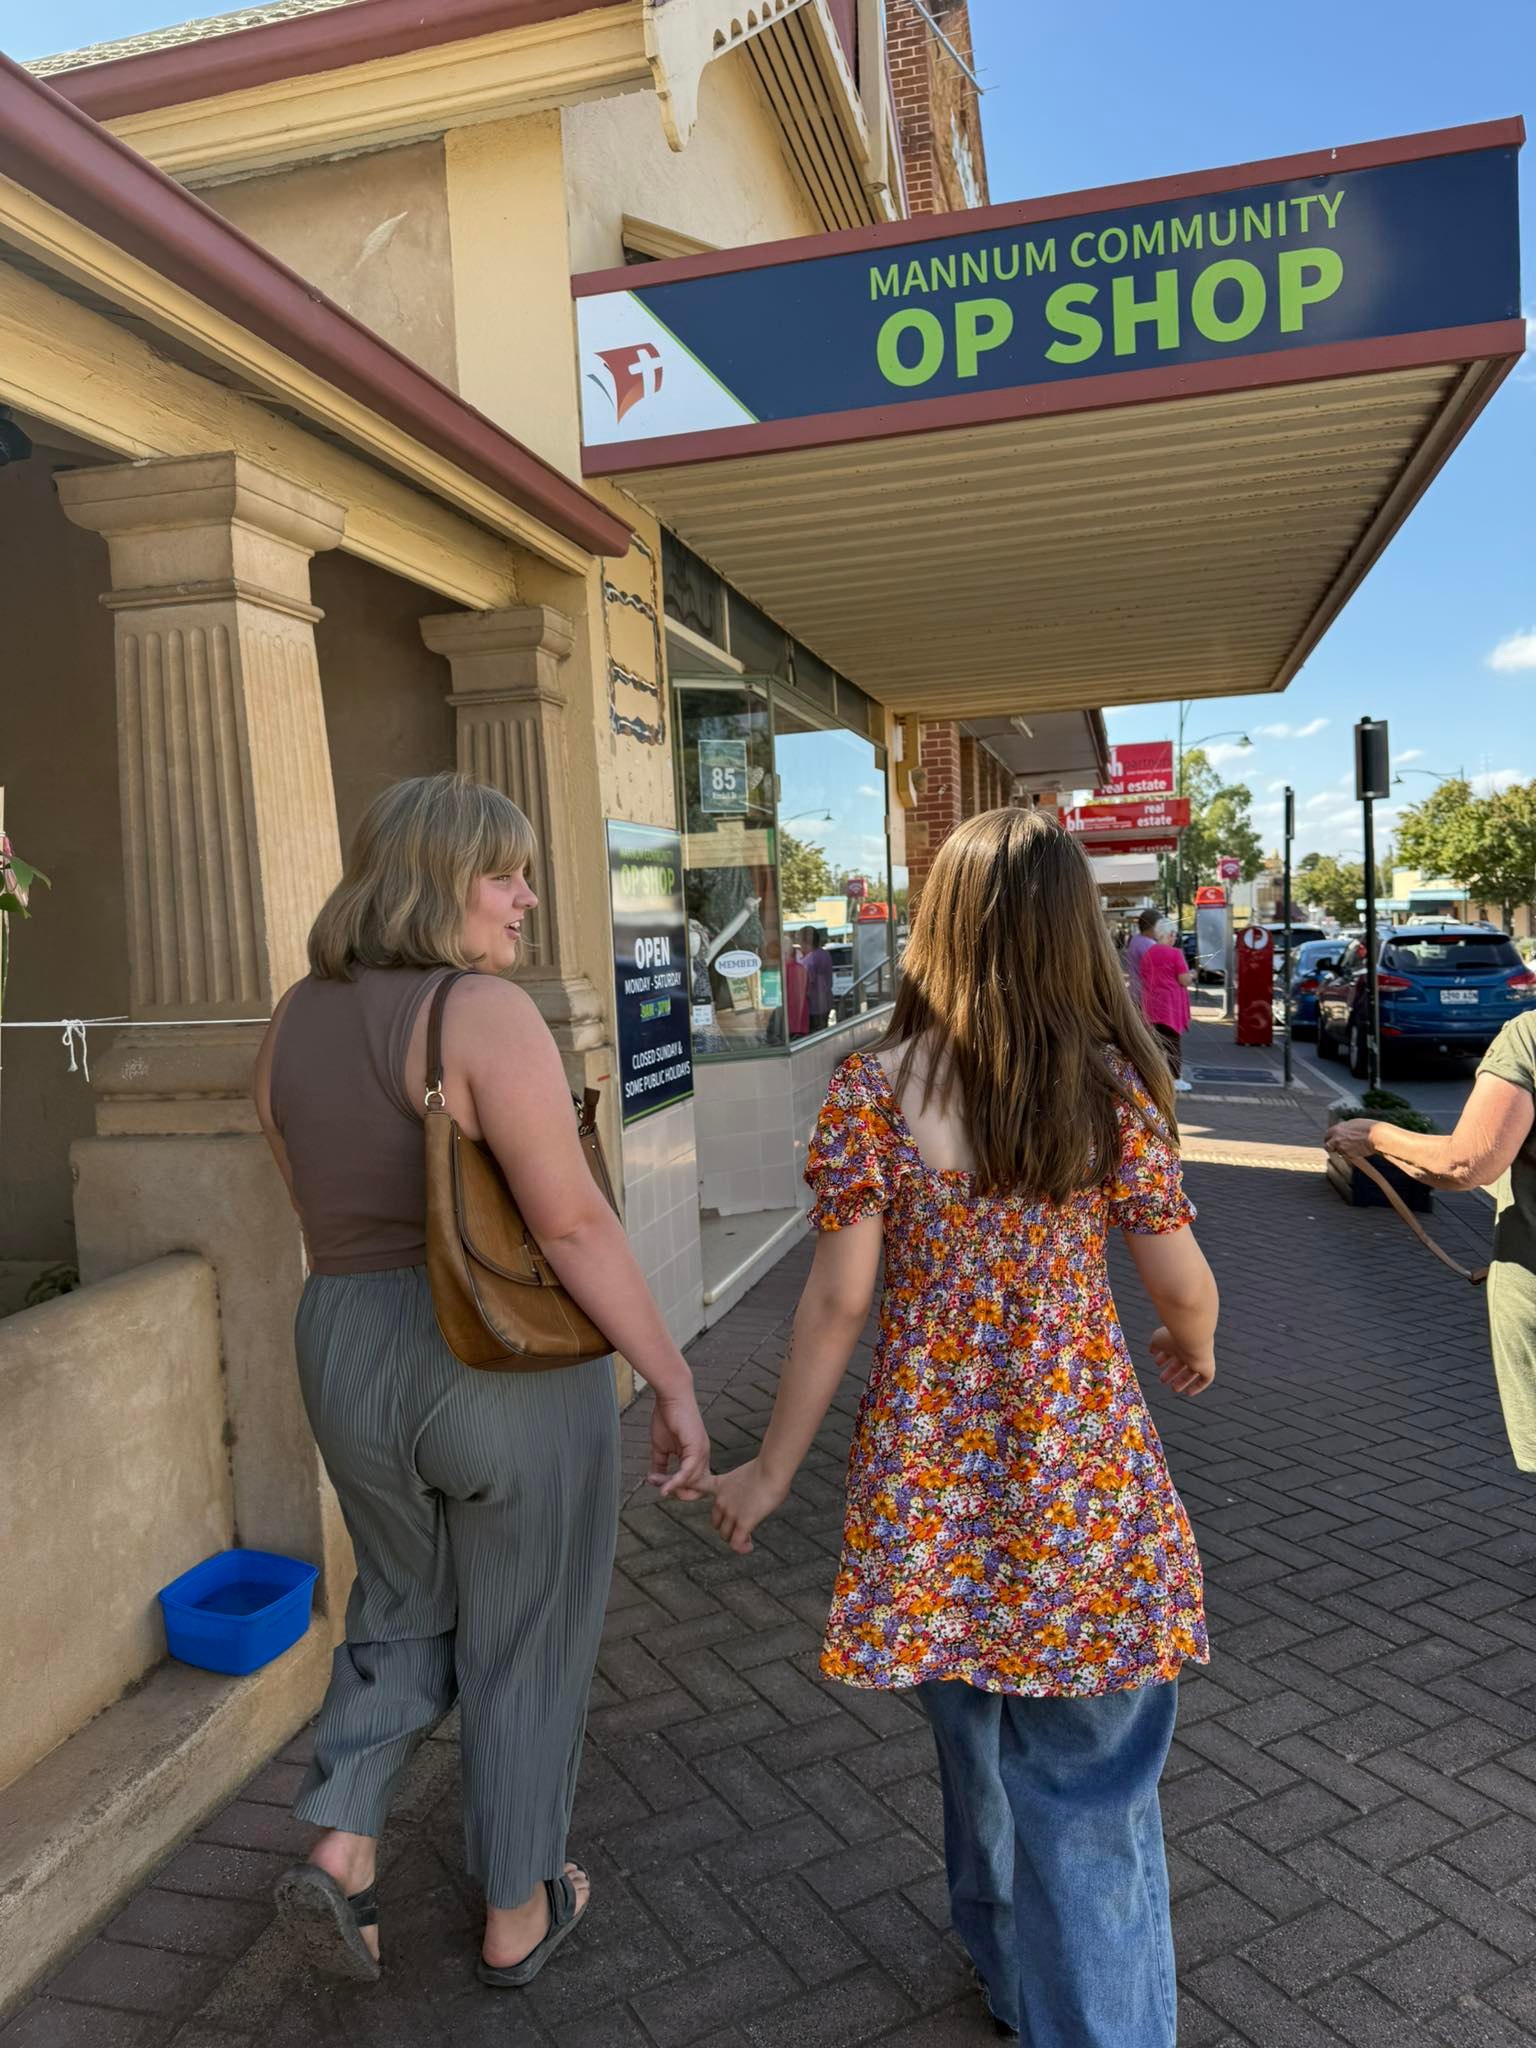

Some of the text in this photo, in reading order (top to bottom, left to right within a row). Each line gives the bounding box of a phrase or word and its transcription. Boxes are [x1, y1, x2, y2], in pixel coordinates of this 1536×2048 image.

[869, 190, 1346, 300] MANNUM COMMUNITY
[876, 247, 1344, 387] OP SHOP
[712, 767, 736, 791] 85
[1127, 779, 1167, 792] estate
[1137, 815, 1172, 827] estate
[1144, 802, 1165, 815] real
[620, 863, 675, 897] OP SHOP
[635, 936, 671, 970] OPEN
[718, 958, 758, 970] MEMBER
[624, 976, 651, 995] MONDAY
[653, 971, 681, 990] SATURDAY
[632, 1040, 683, 1070] CLOSED SUNDAY &
[625, 1060, 691, 1098] SOME PUBLIC HOLIDAYS
